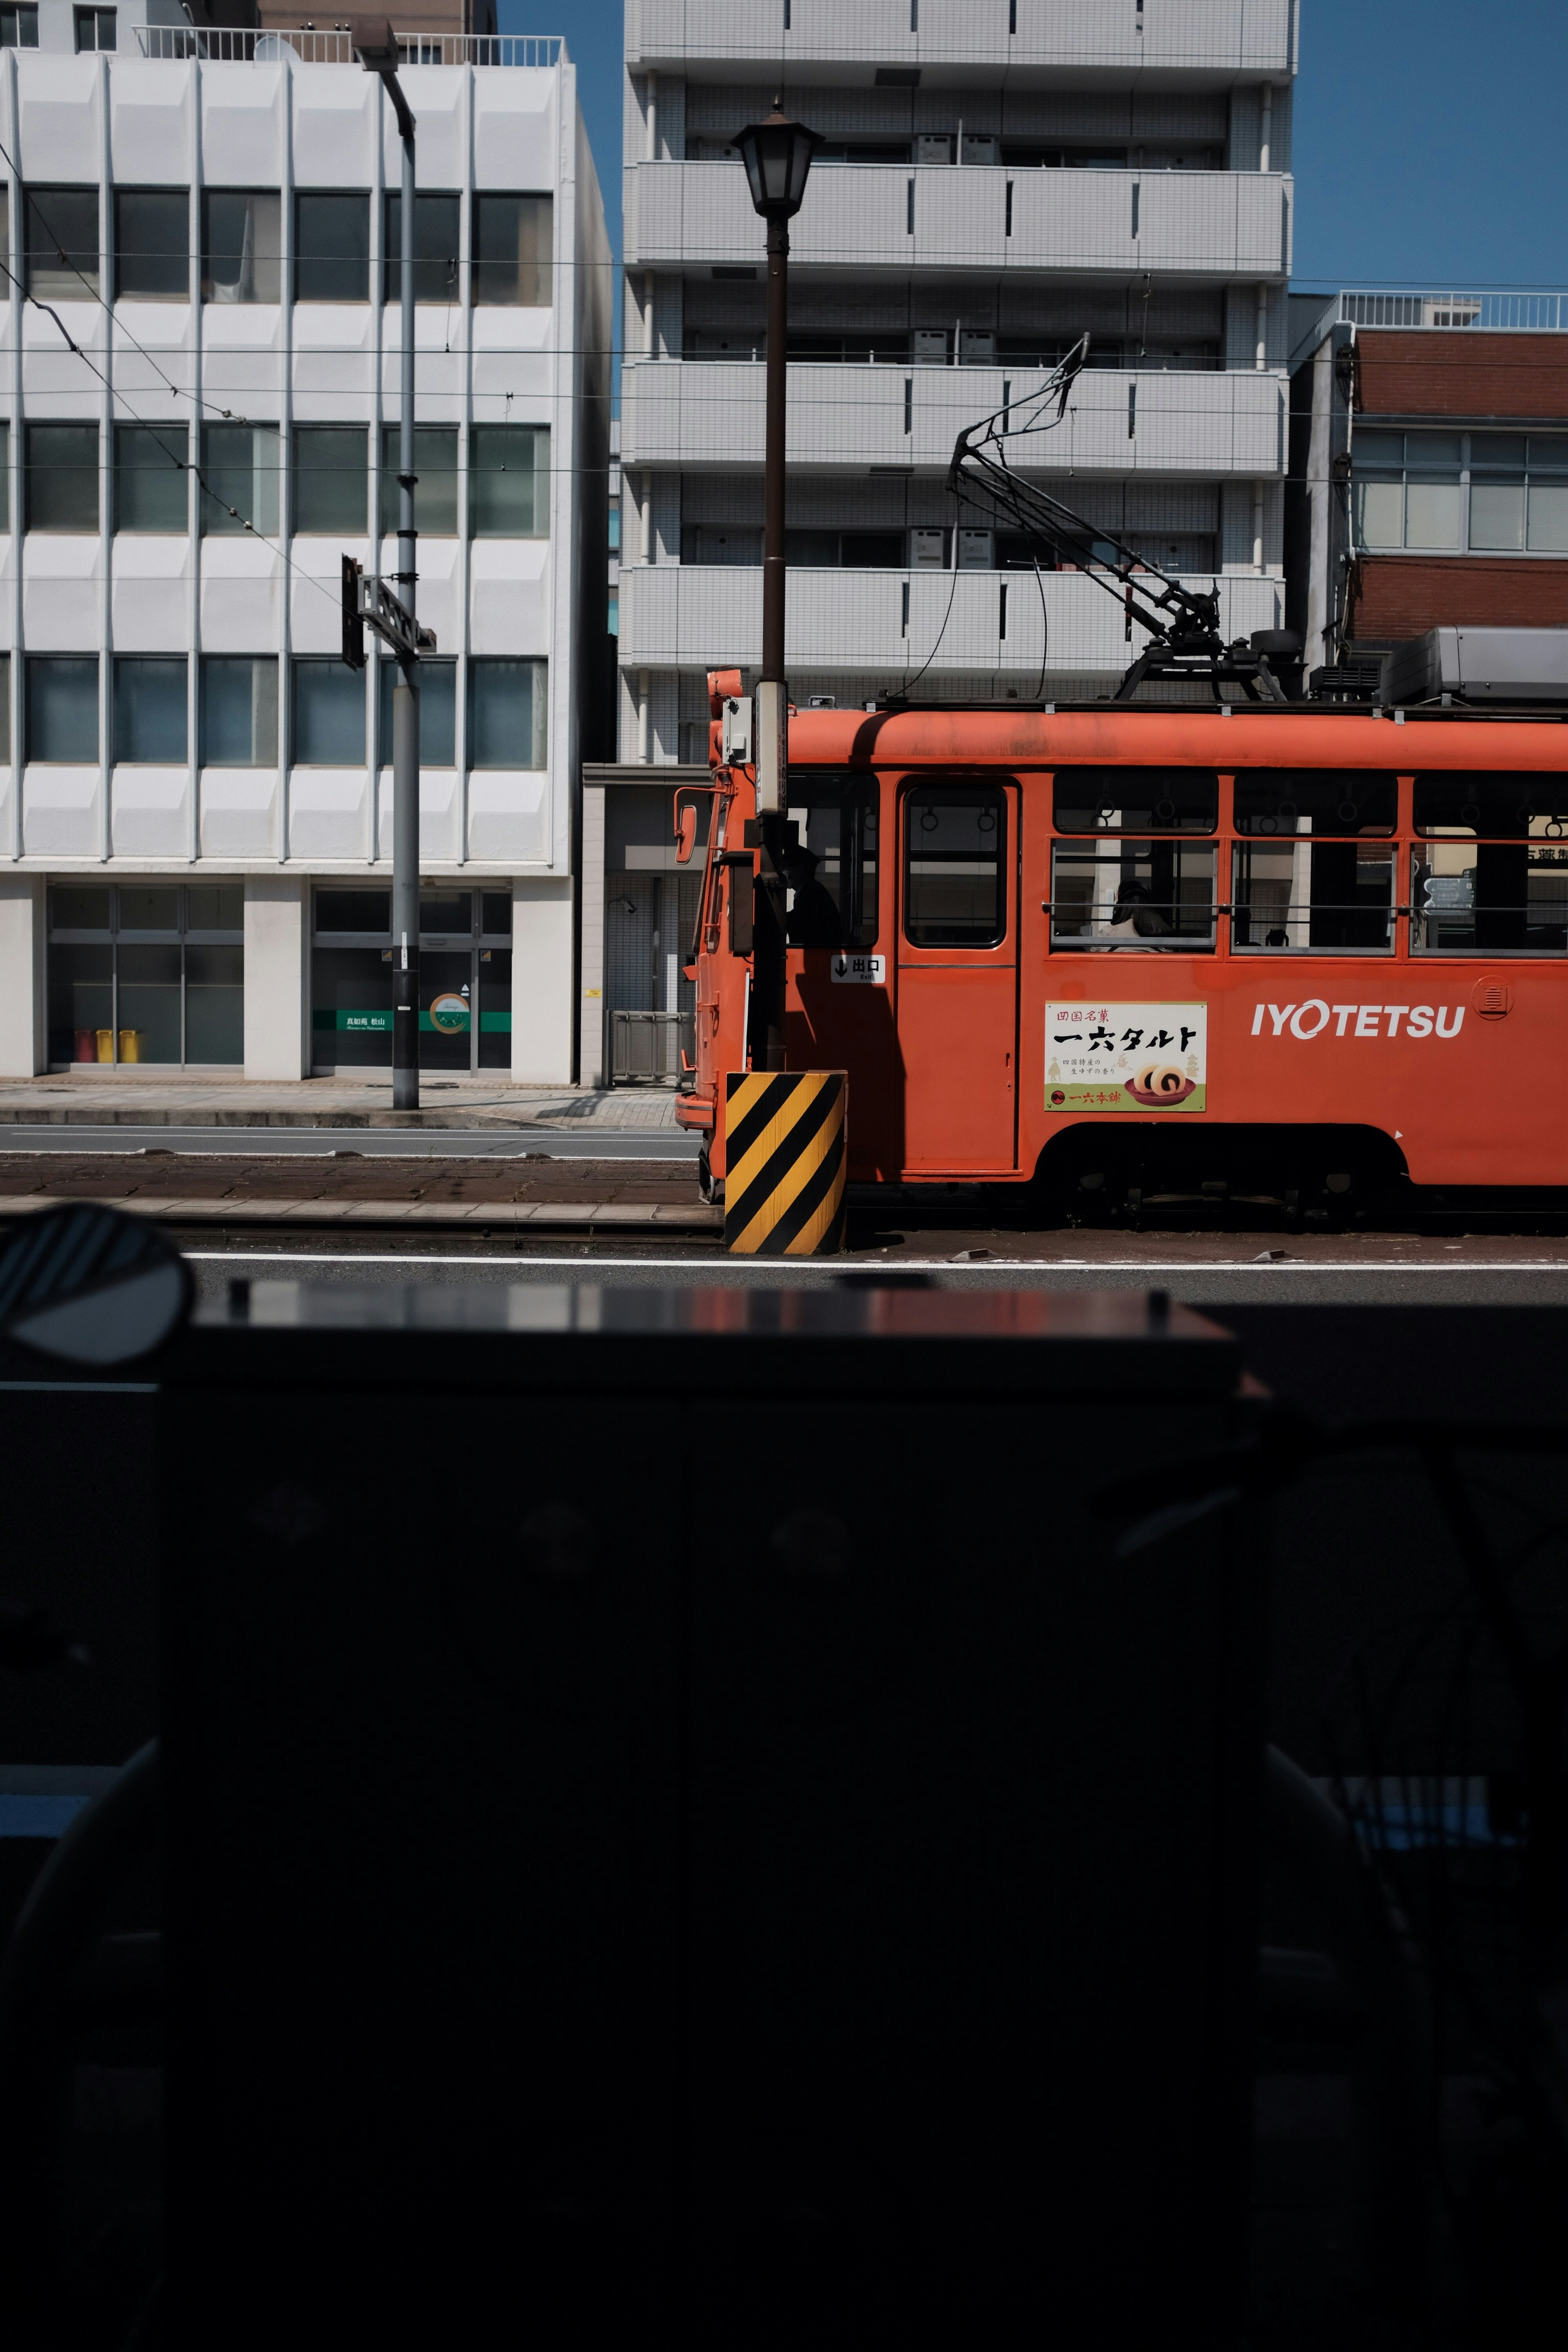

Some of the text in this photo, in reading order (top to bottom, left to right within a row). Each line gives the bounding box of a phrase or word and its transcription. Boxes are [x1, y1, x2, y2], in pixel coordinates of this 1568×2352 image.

[853, 959, 879, 972] 出口
[1057, 1009, 1109, 1023] 四国名菓
[1251, 999, 1465, 1040] IYOTETSU
[1054, 1026, 1196, 1052] 一六タルト
[1069, 1091, 1121, 1105] 一六本舗
